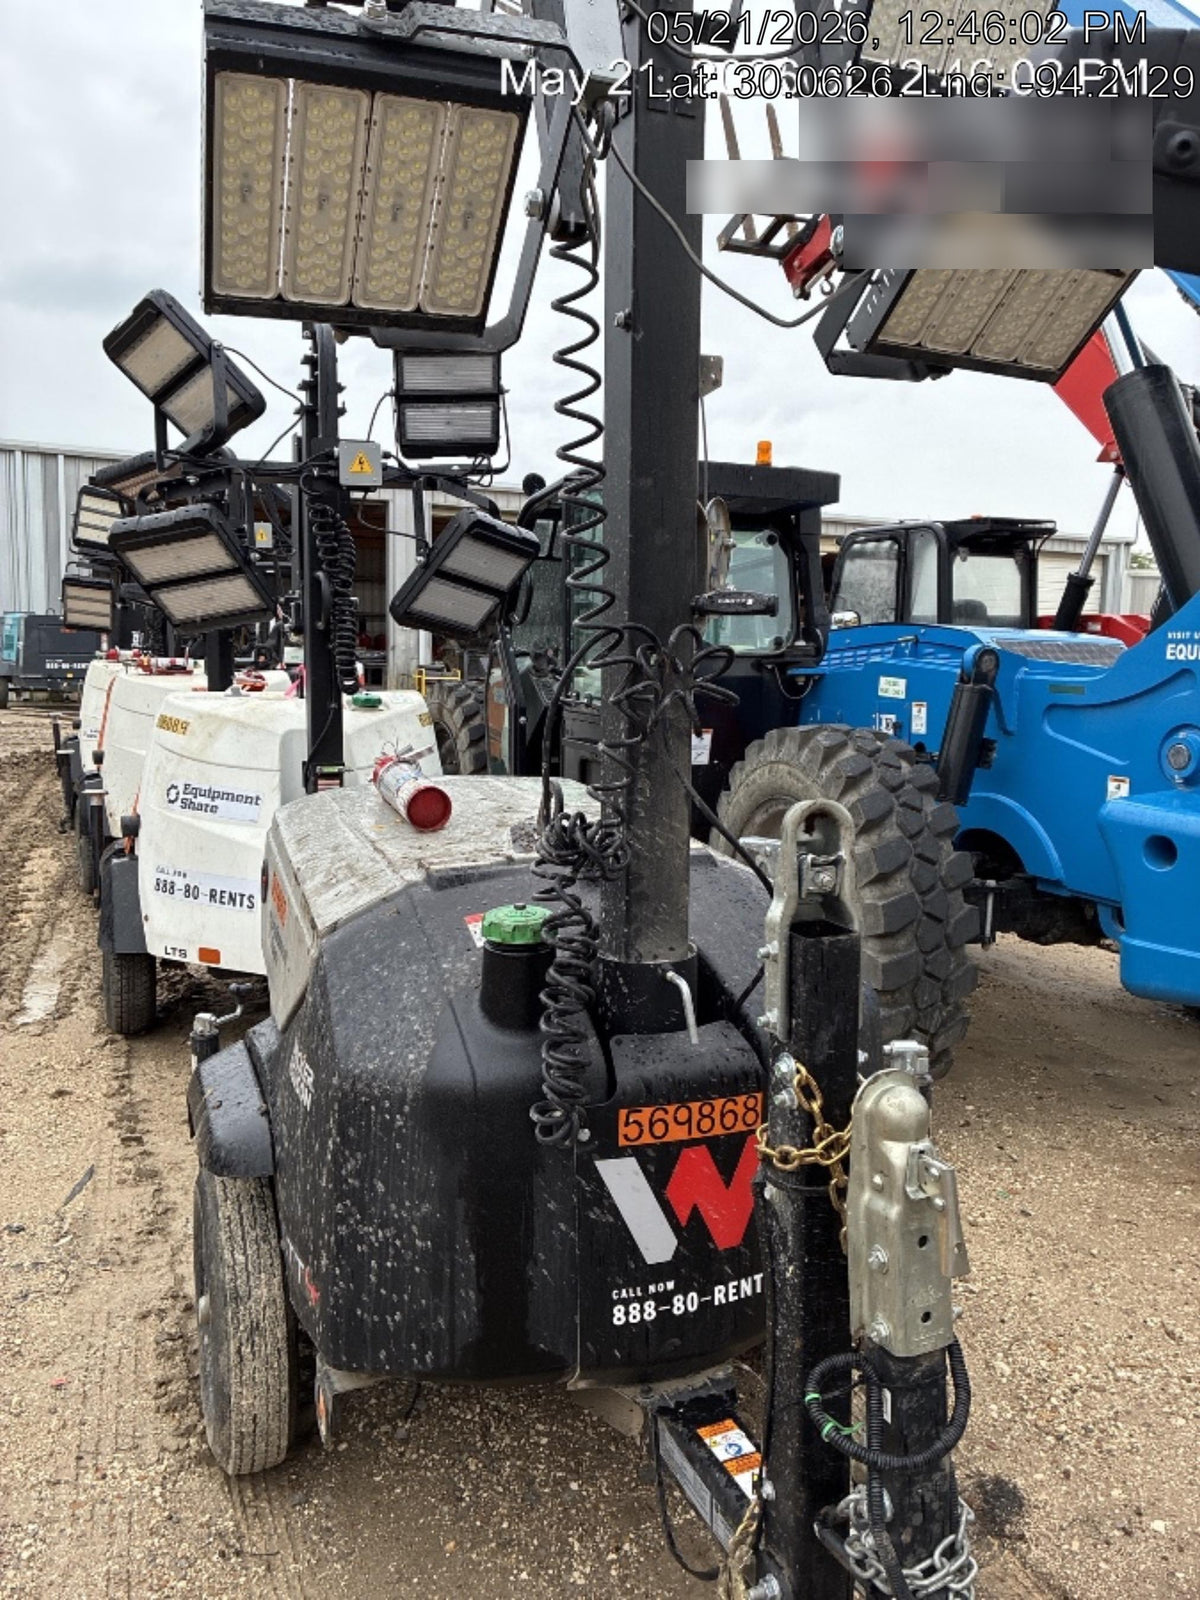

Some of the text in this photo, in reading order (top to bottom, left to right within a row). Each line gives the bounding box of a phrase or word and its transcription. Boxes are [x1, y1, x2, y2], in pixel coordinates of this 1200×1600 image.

[180, 797, 219, 814] Share
[182, 784, 262, 806] Equipment
[154, 878, 255, 909] 888-80-RENTS
[622, 1094, 760, 1142] 569868
[612, 1280, 675, 1300] CALL NOW
